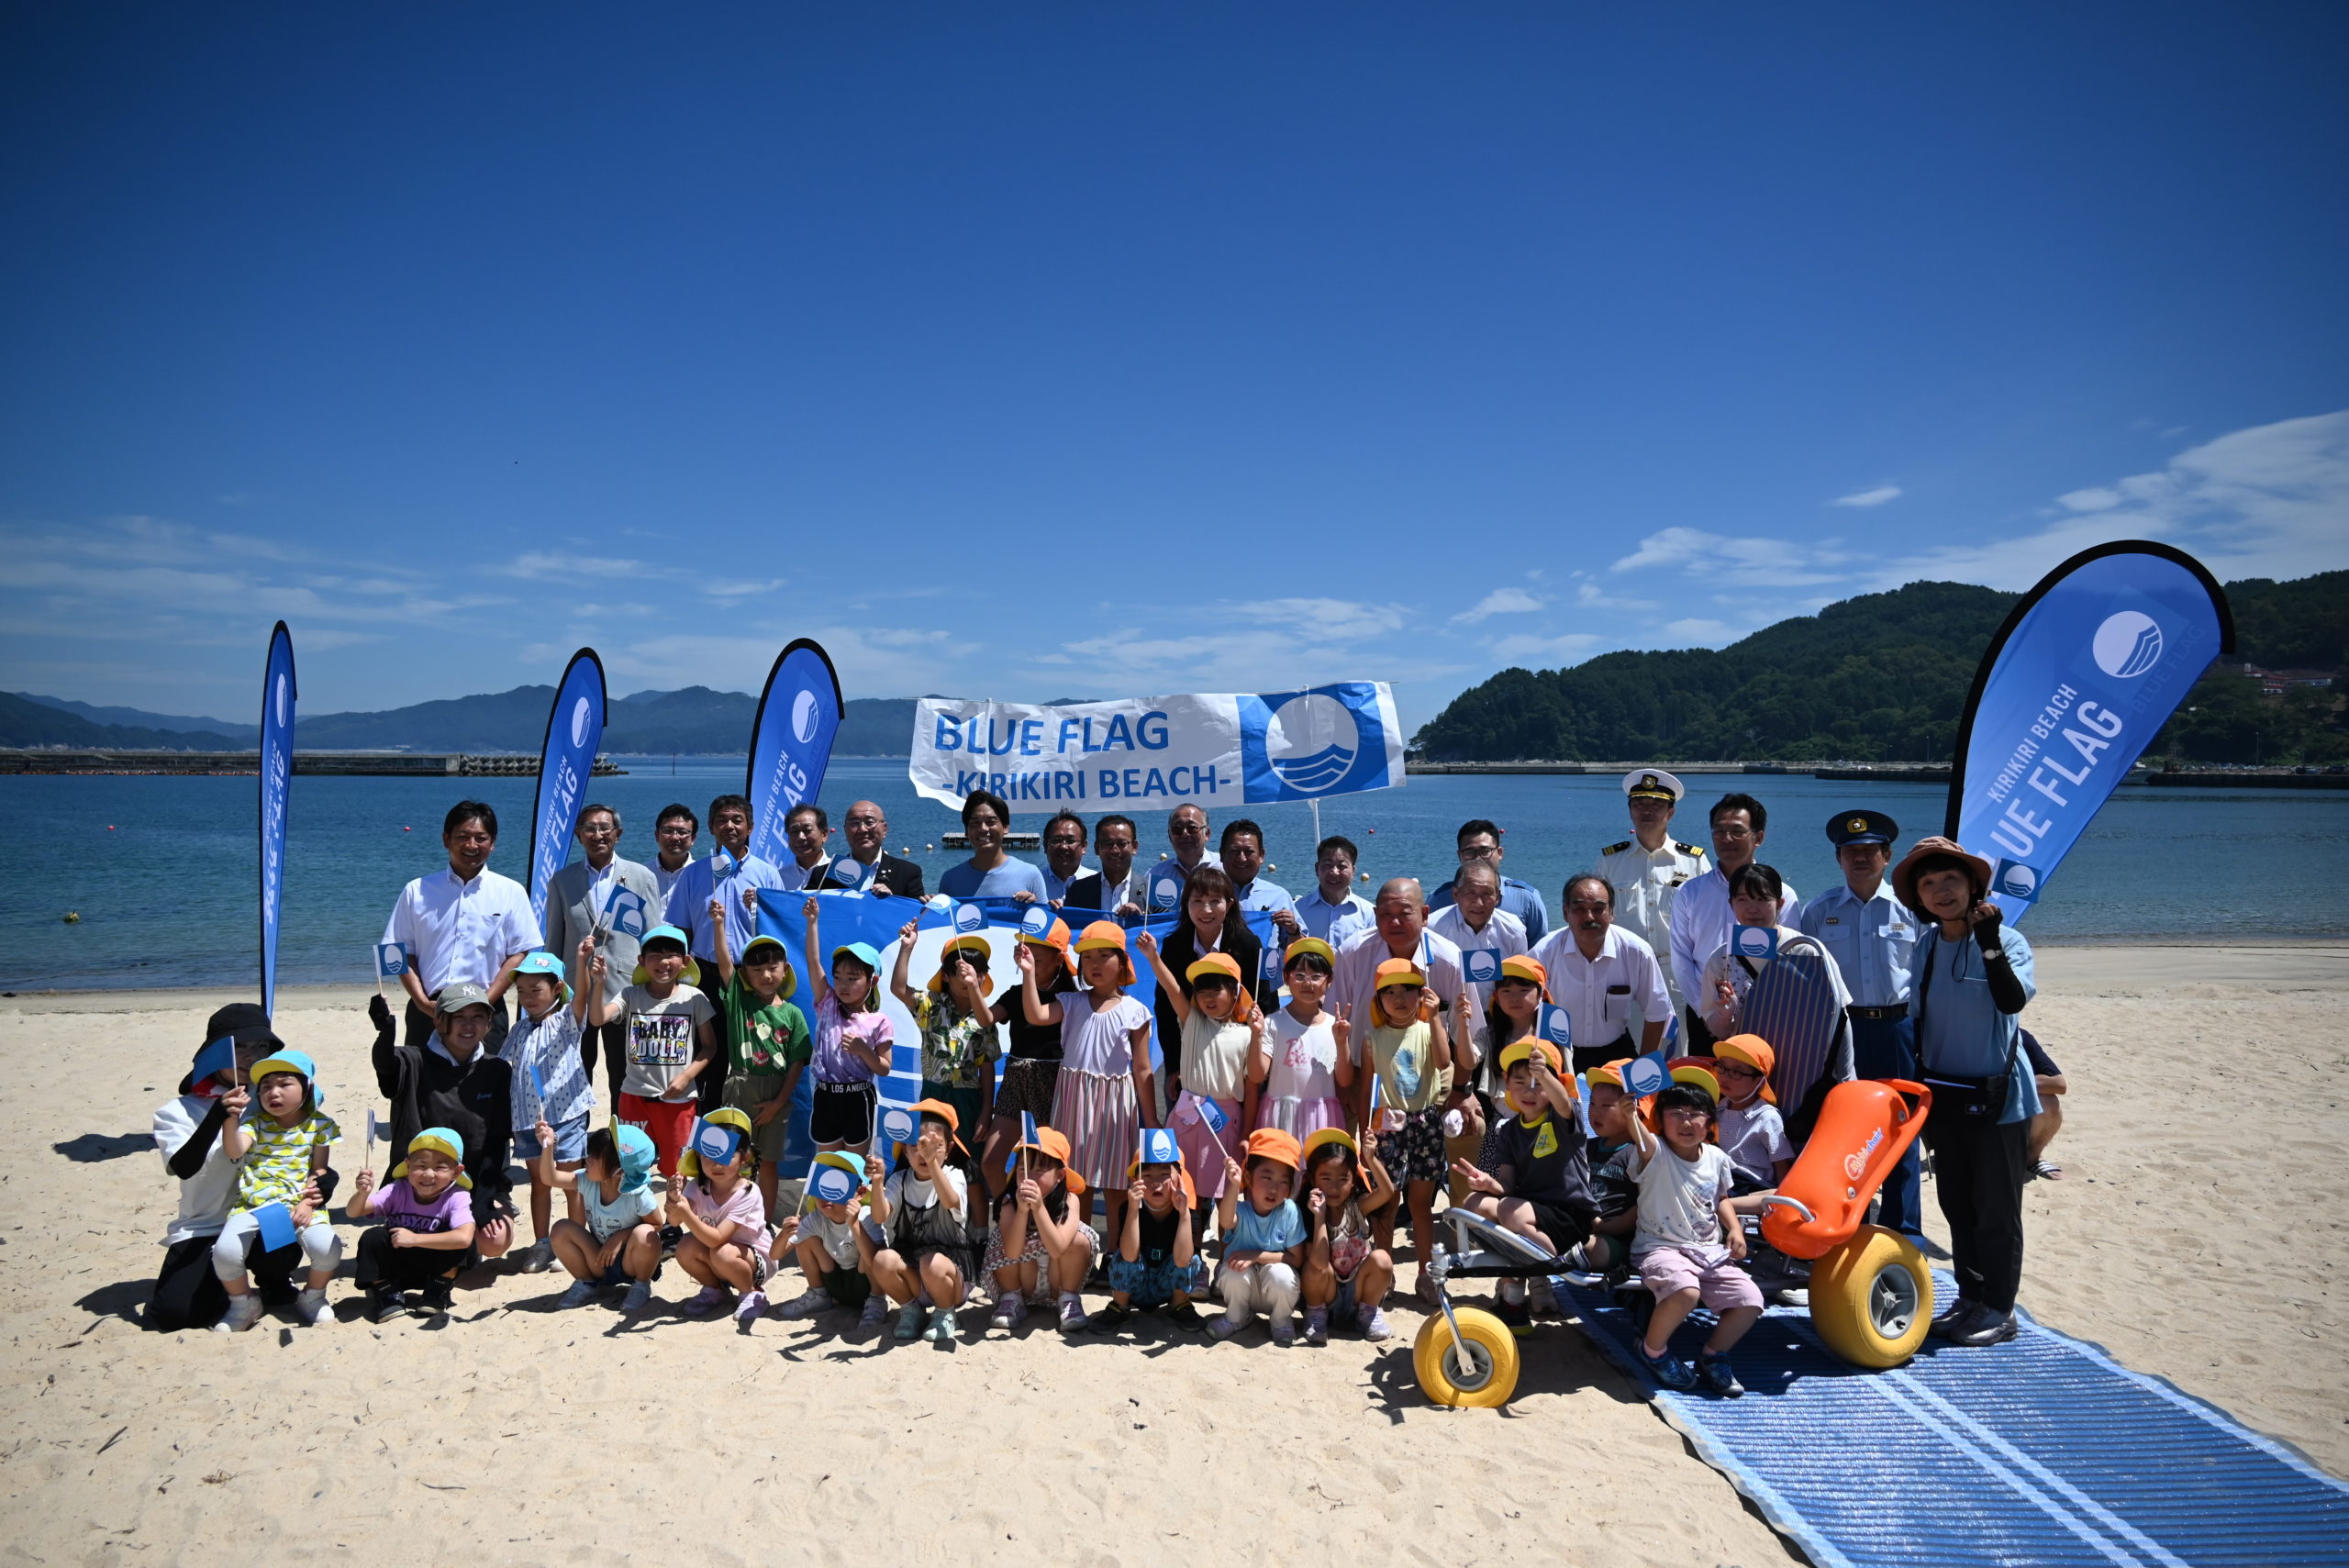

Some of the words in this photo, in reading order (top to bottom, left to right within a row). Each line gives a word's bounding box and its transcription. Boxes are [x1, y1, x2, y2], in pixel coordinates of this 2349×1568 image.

[934, 714, 1045, 756] BLUE
[1057, 711, 1169, 755] FLAG
[1987, 737, 2041, 804] KIRIKIRI
[2031, 683, 2077, 740] BEACH
[2027, 700, 2123, 807] FLAG
[551, 766, 578, 851] FLAG
[756, 795, 776, 850] KIRIKIRI
[771, 750, 789, 795] BEACH
[637, 1039, 677, 1058] DOLL
[639, 1020, 685, 1039] BABY
[831, 1084, 844, 1093] LOS
